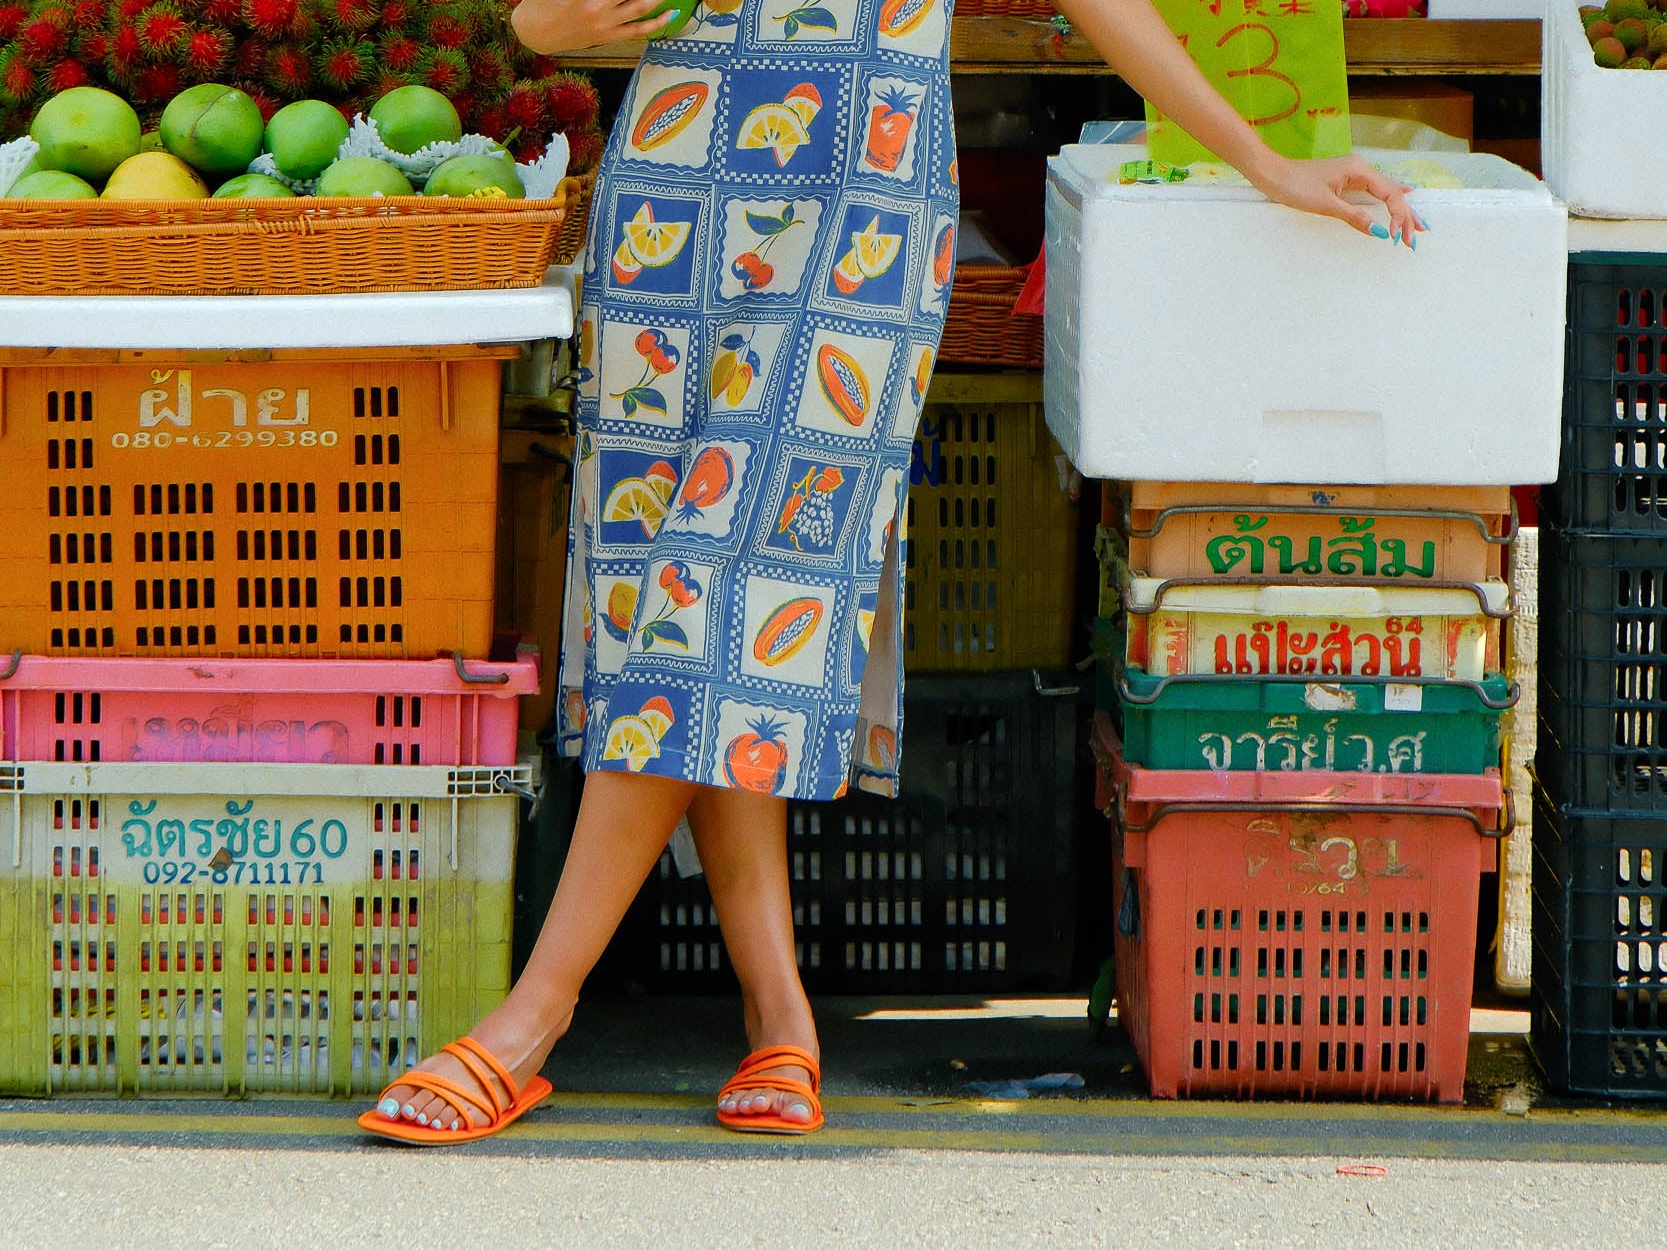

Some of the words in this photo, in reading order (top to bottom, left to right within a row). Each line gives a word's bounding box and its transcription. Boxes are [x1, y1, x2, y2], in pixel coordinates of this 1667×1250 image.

[111, 430, 338, 449] 080-6299380
[1205, 514, 1436, 579] ต้นส้ม
[143, 860, 325, 885] 092-8711171
